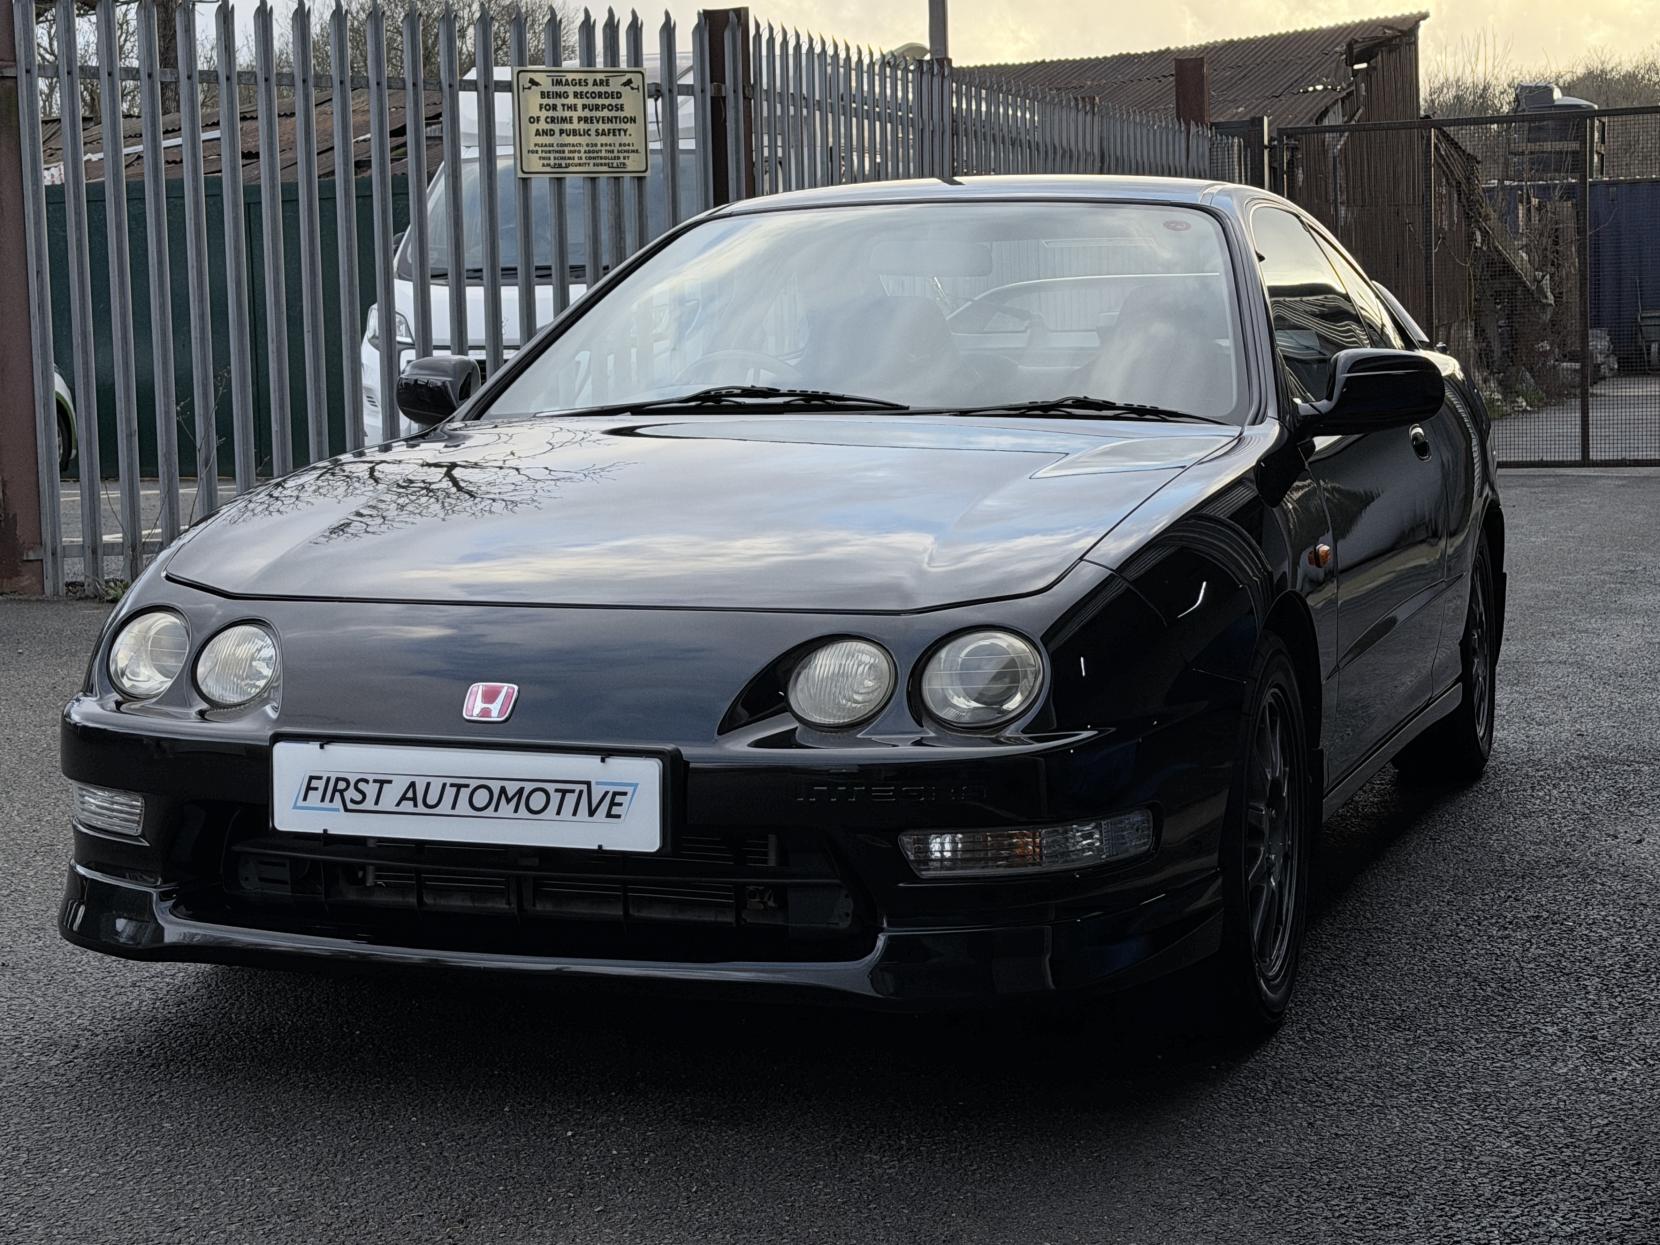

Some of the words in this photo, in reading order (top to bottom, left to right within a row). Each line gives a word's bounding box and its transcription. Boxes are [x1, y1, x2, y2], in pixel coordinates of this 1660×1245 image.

[552, 79, 588, 87] IMAGES
[592, 79, 610, 87] ARE
[540, 91, 569, 99] BEING
[573, 91, 622, 99] RECORDED
[535, 129, 555, 137] AND
[559, 129, 591, 137] PUBLIC
[595, 129, 632, 137] SAFETY.
[302, 775, 393, 811] FIRST
[396, 780, 628, 819] AUTOMOTIVE
